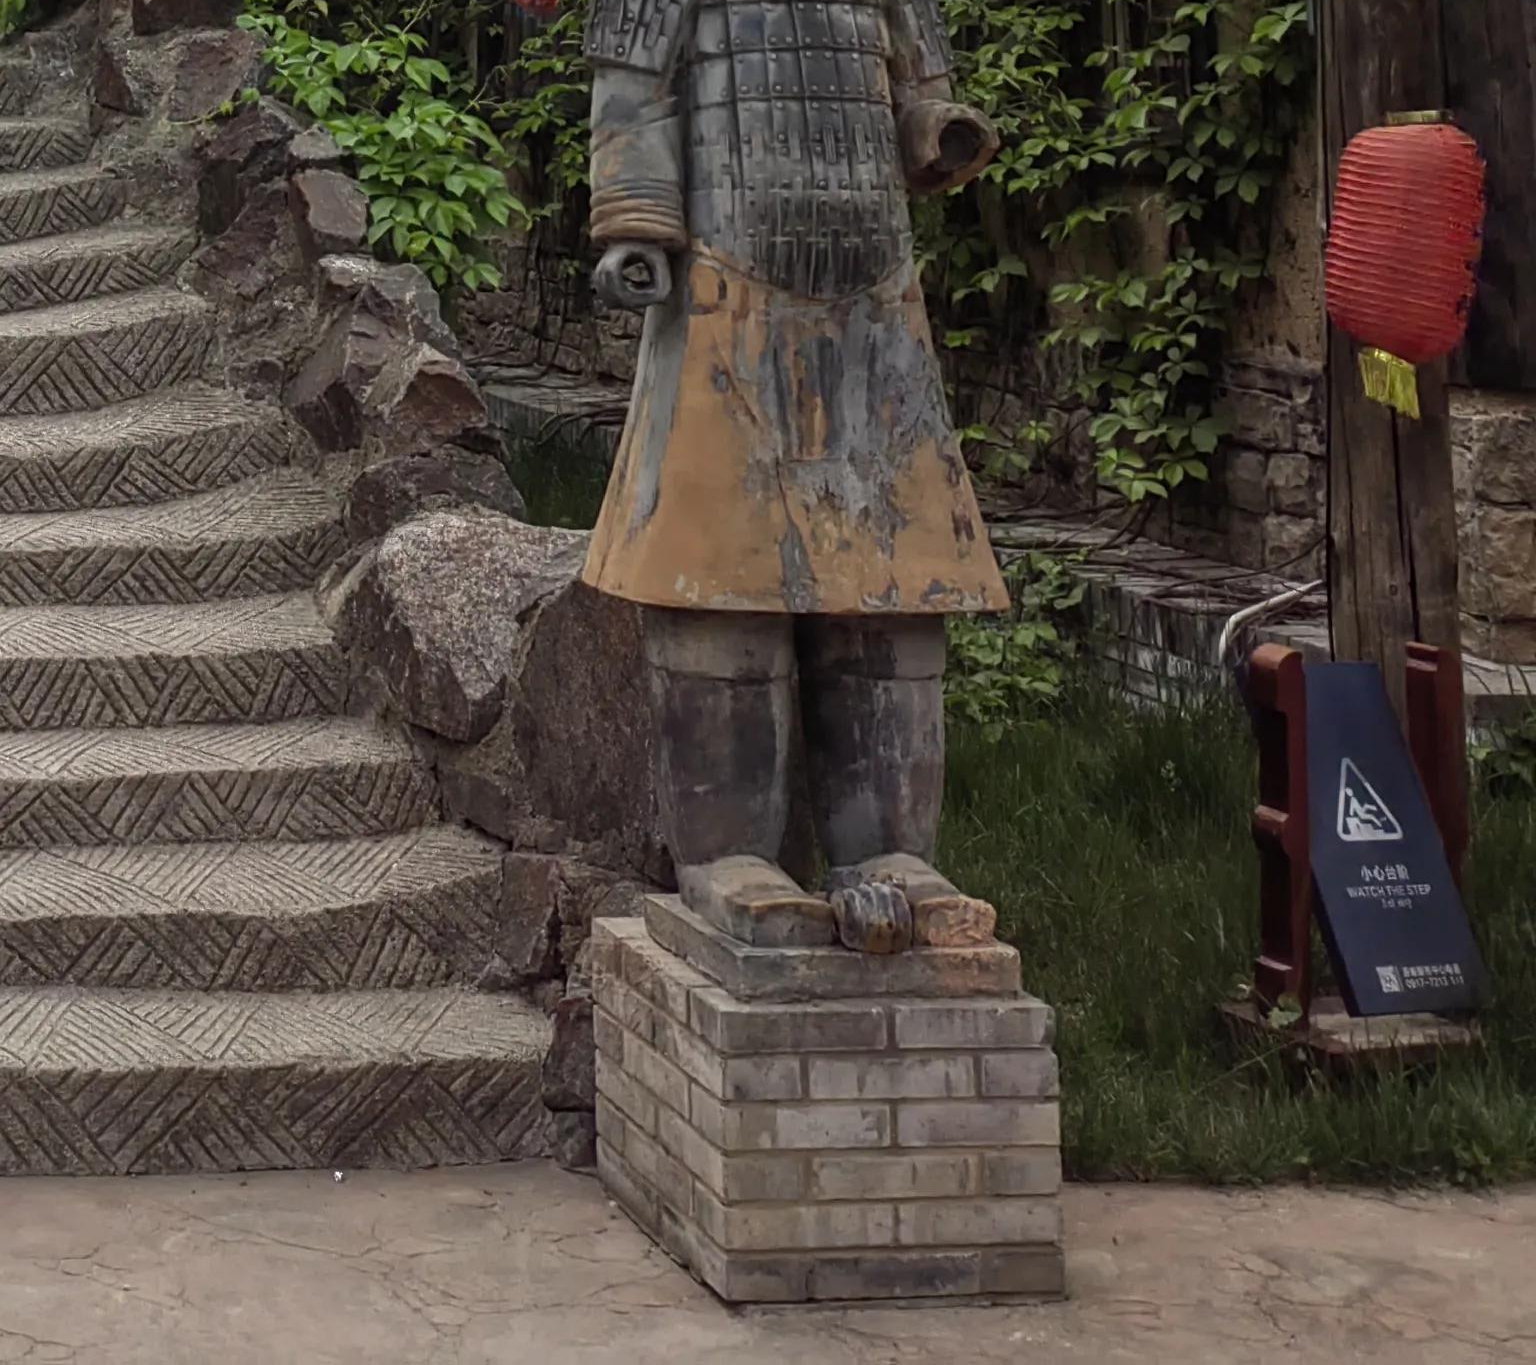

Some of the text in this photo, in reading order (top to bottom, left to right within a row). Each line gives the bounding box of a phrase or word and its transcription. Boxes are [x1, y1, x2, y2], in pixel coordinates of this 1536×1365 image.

[1361, 864, 1409, 881] 小心台阶
[1346, 884, 1431, 898] WATCH THE STEP
